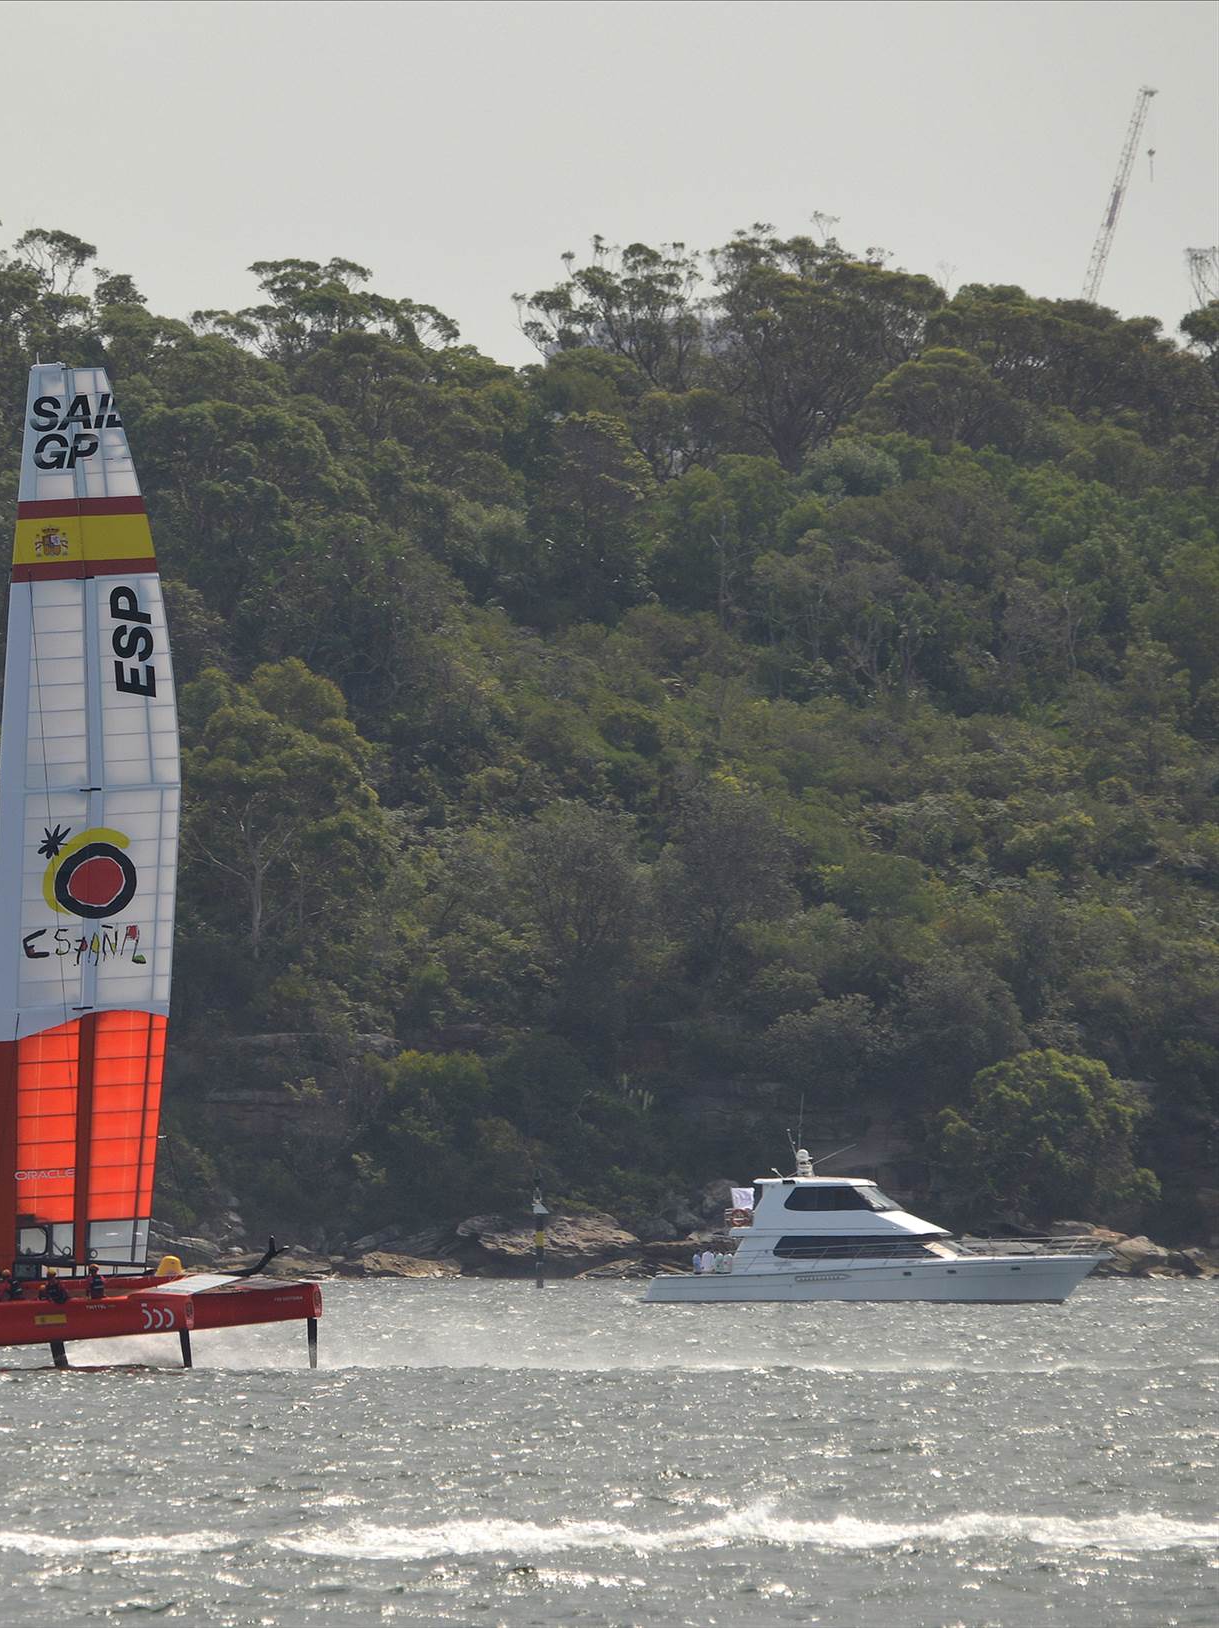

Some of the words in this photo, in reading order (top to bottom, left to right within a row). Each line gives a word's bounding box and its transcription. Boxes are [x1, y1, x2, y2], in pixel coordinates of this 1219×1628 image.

[30, 394, 123, 431] SAIL
[33, 433, 99, 470] GP
[110, 586, 156, 698] ESP
[14, 1168, 76, 1181] ORACLE
